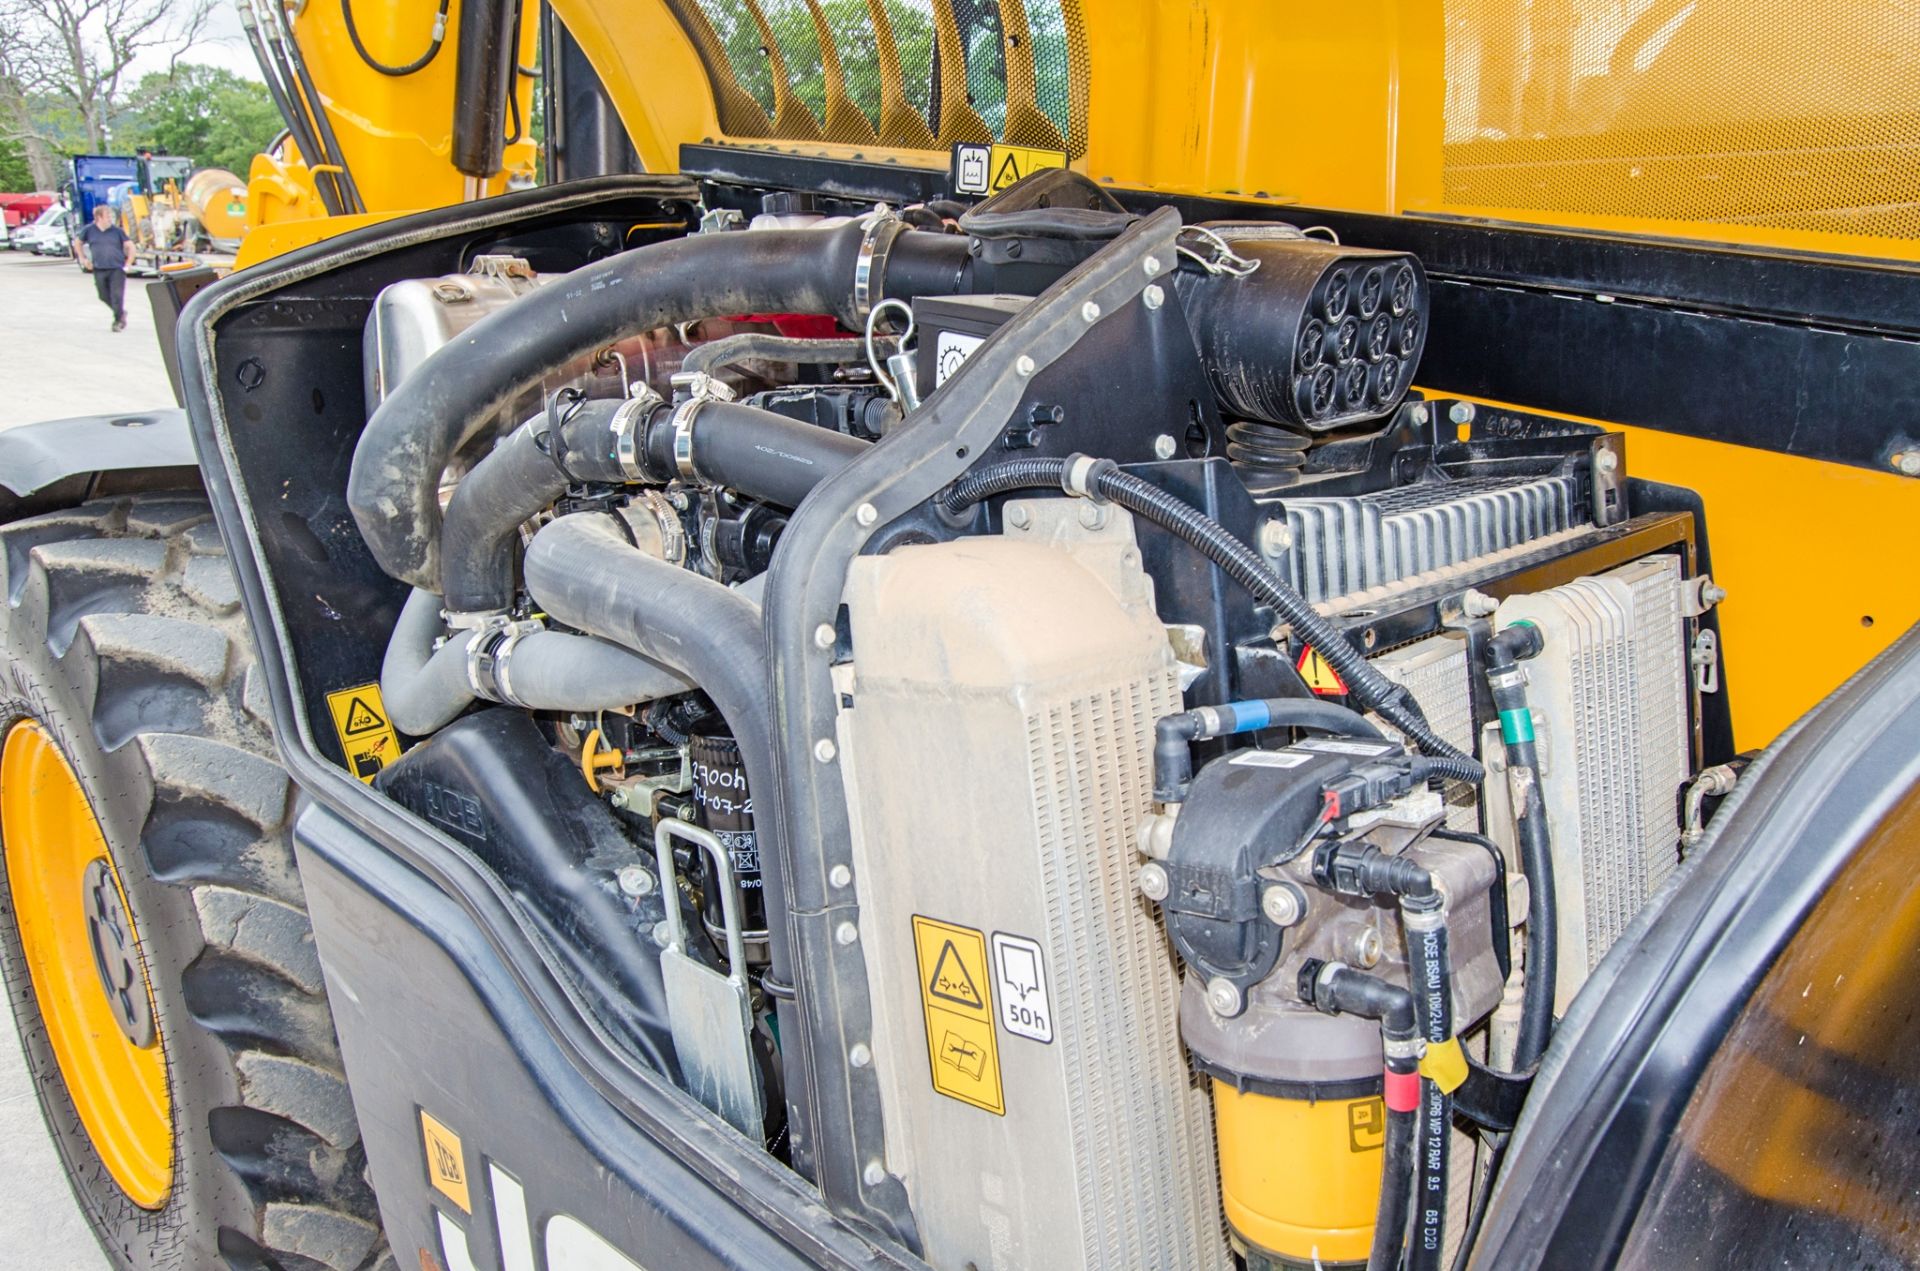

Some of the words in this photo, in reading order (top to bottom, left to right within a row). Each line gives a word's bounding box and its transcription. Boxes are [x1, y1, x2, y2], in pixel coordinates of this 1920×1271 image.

[692, 761, 746, 791] 2700h
[1423, 928, 1439, 958] HOSE
[1429, 1118, 1442, 1135] WP
[1428, 1136, 1442, 1148] 12
[433, 1139, 461, 1180] JCB
[1424, 1227, 1437, 1250] D20
